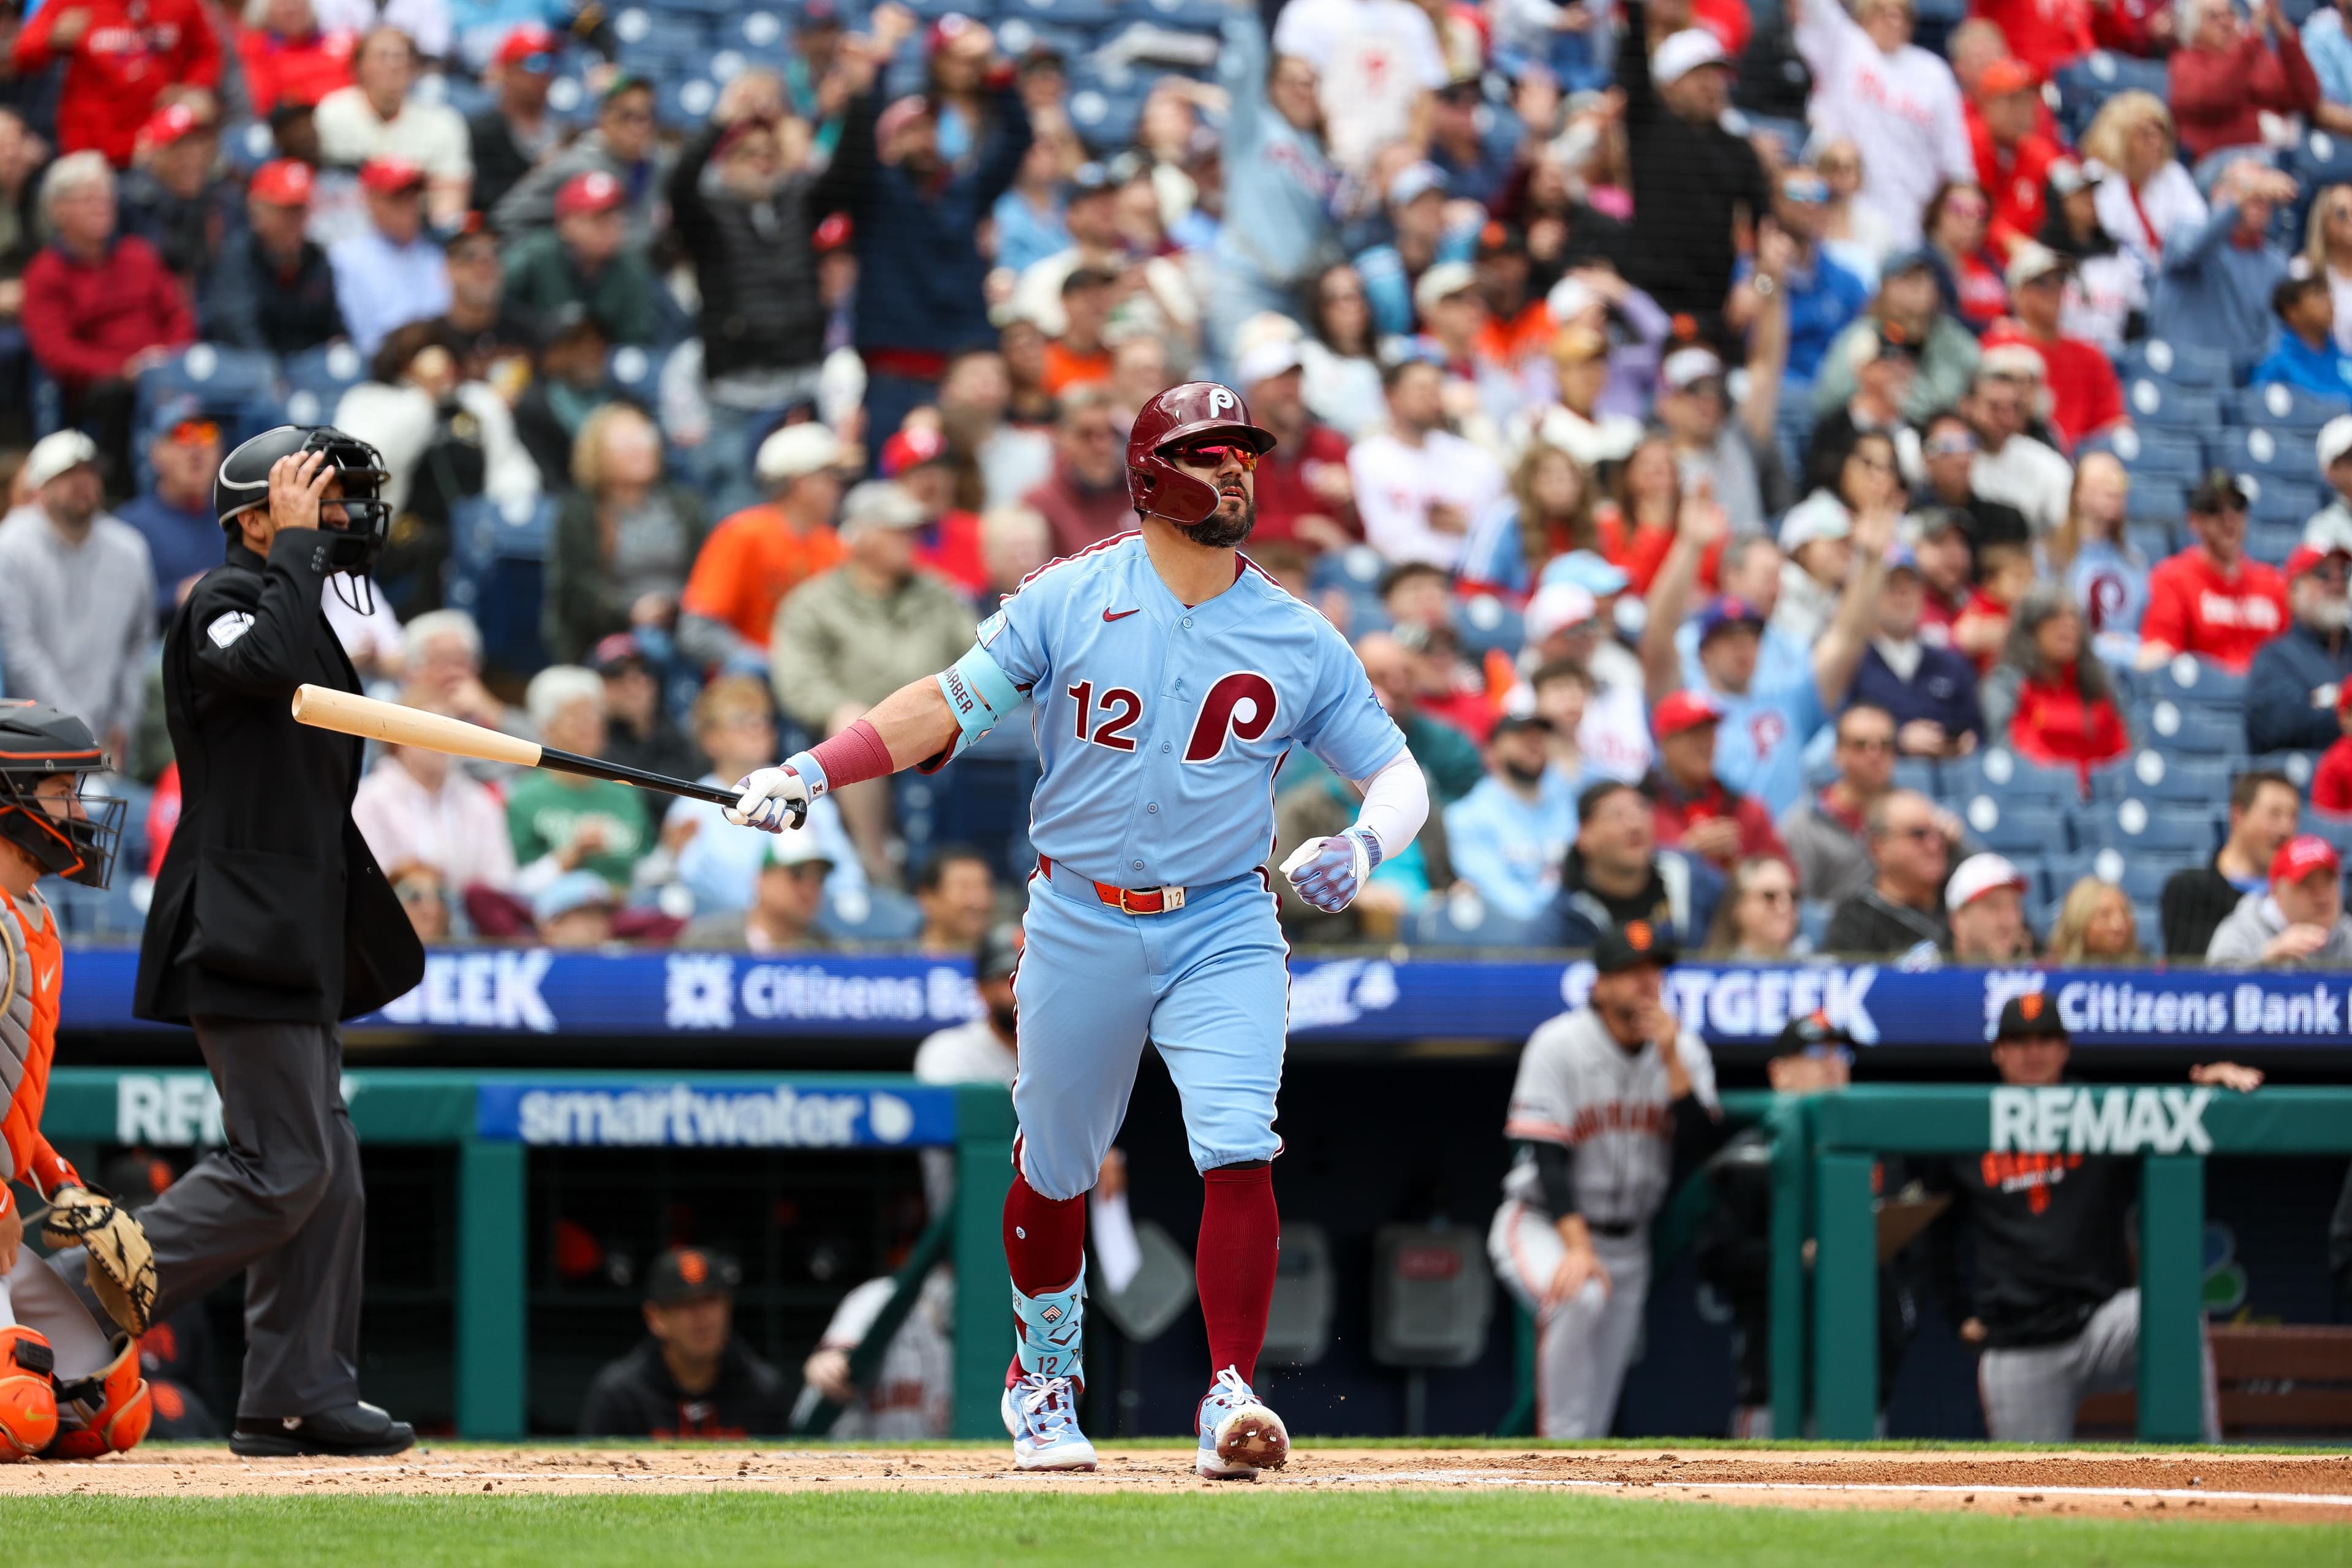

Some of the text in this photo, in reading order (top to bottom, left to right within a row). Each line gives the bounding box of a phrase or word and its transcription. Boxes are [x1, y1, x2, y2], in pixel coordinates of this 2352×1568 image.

[1208, 387, 1235, 419] P
[944, 667, 974, 715] ARBER
[1067, 678, 1144, 753] 12
[1180, 669, 1279, 764] P
[1167, 891, 1183, 908] 12
[2057, 980, 2228, 1033] Citizens
[2234, 981, 2341, 1035] Bank
[518, 1083, 862, 1147] smartwater
[1037, 1355, 1058, 1375] 12
